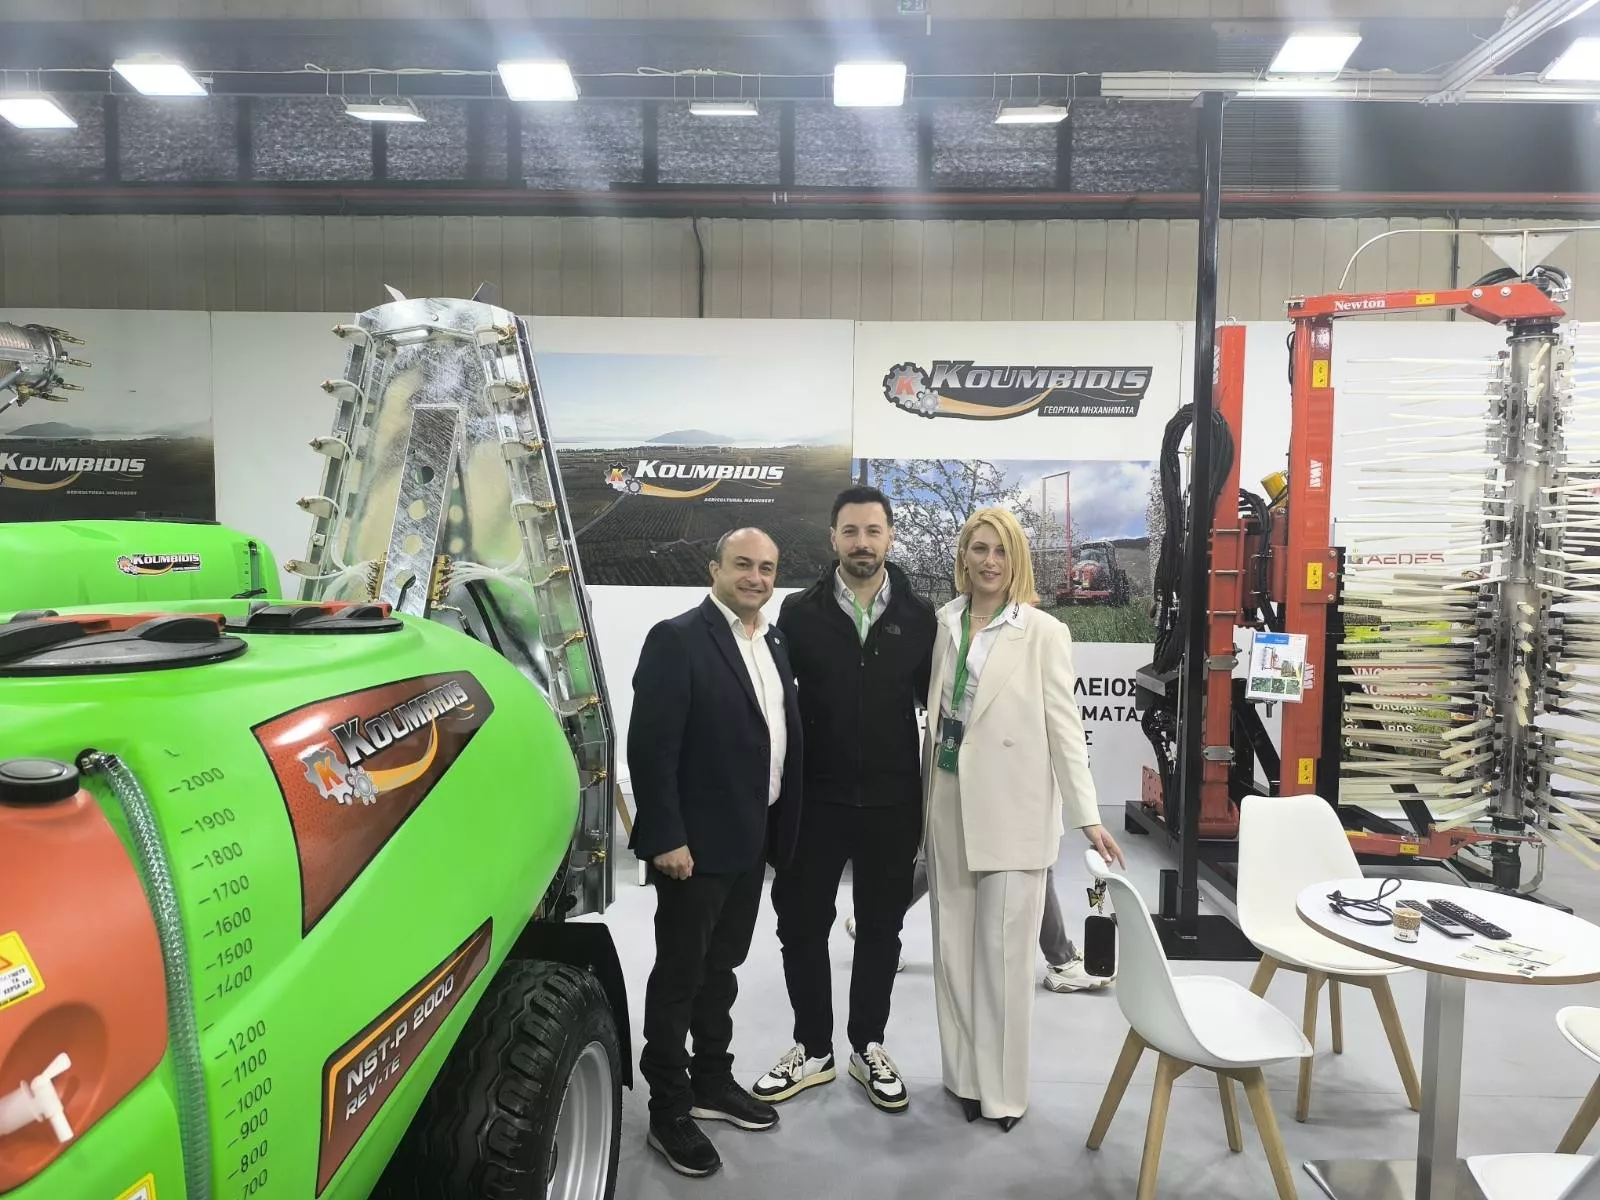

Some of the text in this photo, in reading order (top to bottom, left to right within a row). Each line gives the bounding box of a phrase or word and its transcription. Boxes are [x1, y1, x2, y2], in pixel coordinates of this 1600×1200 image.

[1334, 299, 1386, 311] Newton
[931, 362, 1149, 389] KOUMBIDIS
[1043, 405, 1134, 415] ΓΕΩΡΓΙΚΑ ΜΗΧΑΝΗΜΑΤΑ
[634, 459, 785, 480] KOUMBIDIS
[133, 554, 200, 565] KOUMBIDIS
[1073, 677, 1137, 697] ΛΕΙΟΣ
[331, 680, 470, 766] KOUMBIDIS
[1081, 705, 1139, 722] ΜΑΤΑ
[413, 973, 455, 1032] 2000
